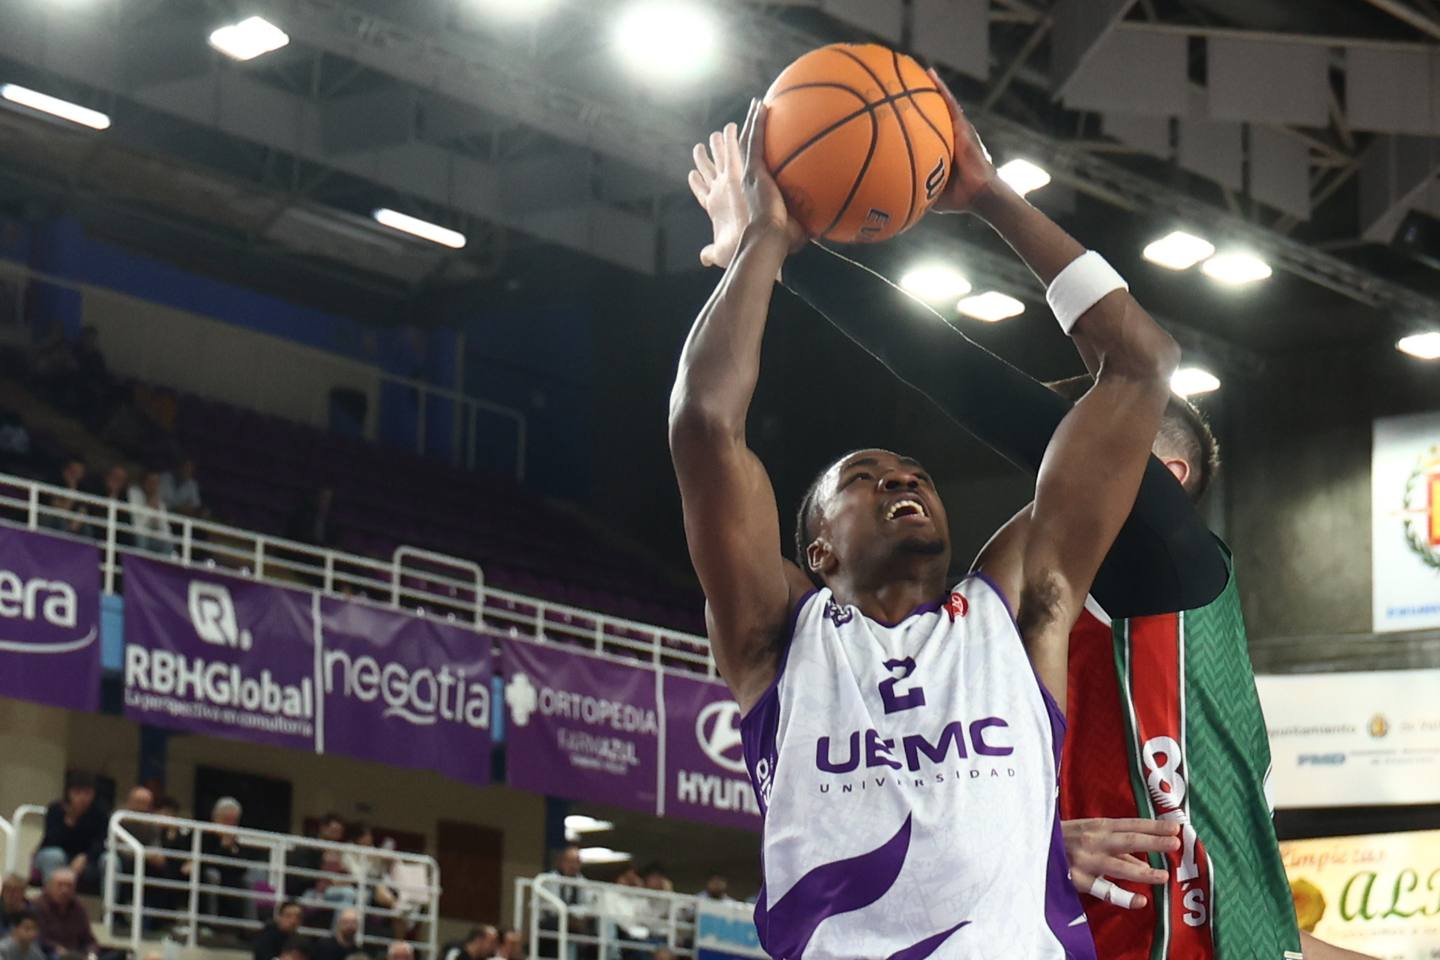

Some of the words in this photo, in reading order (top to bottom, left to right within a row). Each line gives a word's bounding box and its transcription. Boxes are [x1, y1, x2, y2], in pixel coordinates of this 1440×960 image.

[0, 570, 77, 628] era
[125, 644, 313, 719] RBHGlobal
[324, 650, 490, 729] negotia
[878, 656, 926, 715] 2
[538, 688, 659, 735] ORTOPEDIA
[816, 717, 1014, 774] UEMC
[678, 769, 761, 816] HYUN
[819, 768, 1016, 794] UNIVRSIDAD
